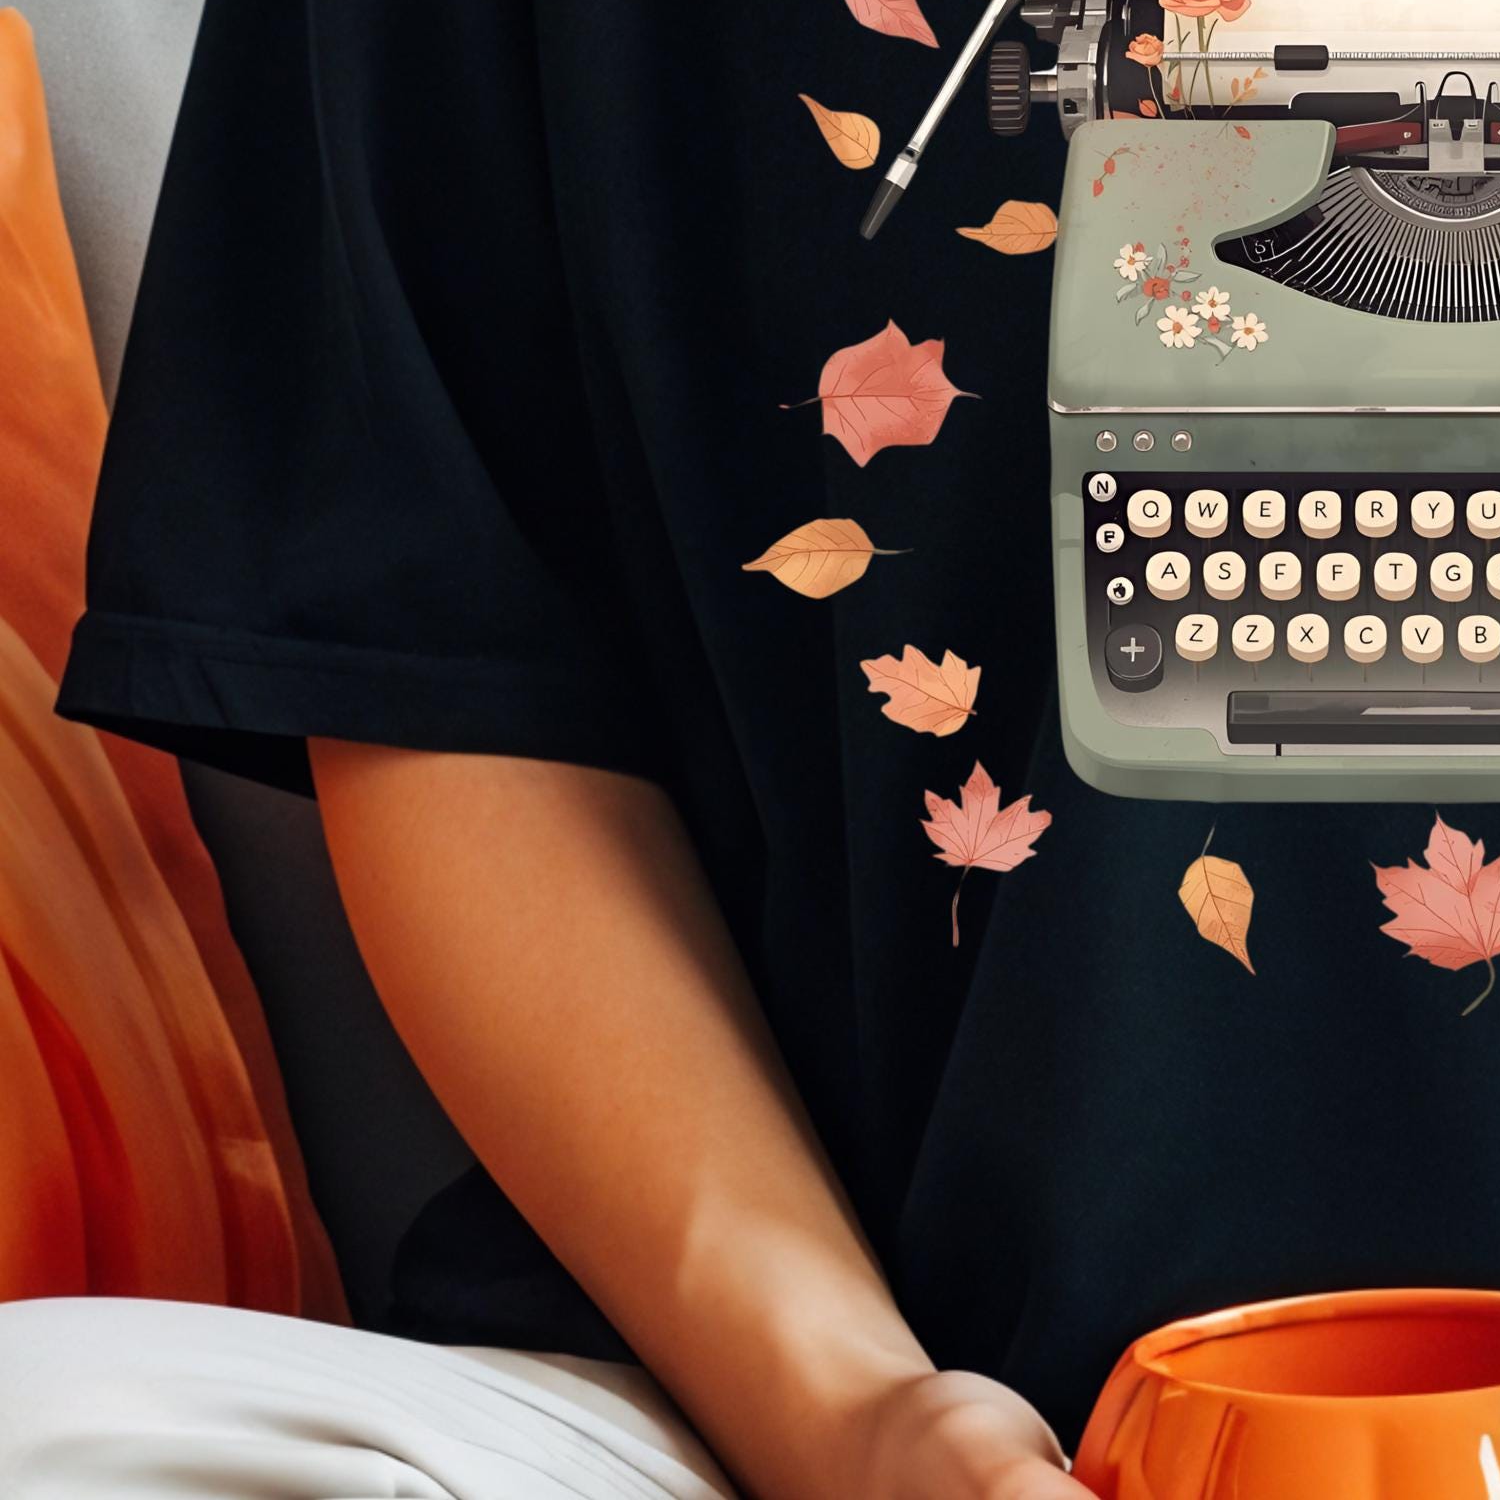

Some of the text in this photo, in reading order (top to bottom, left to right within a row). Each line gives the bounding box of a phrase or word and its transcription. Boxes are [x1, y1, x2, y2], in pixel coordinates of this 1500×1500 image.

[1141, 499, 1161, 520] Q
[1197, 500, 1220, 520] W
[1258, 499, 1273, 519] E
[1314, 499, 1329, 519] R
[1370, 499, 1385, 520] R
[1427, 501, 1441, 520] Y
[1480, 501, 1498, 521] U
[1159, 561, 1179, 581] A
[1217, 561, 1233, 581] S
[1273, 562, 1287, 581] F
[1331, 563, 1345, 582] F
[1387, 562, 1404, 581] T
[1444, 563, 1462, 583] G
[1188, 622, 1205, 644] Z
[1245, 623, 1260, 644] Z
[1299, 625, 1315, 645] X
[1358, 625, 1374, 646] C
[1413, 626, 1432, 646] V
[1473, 624, 1488, 645] B
